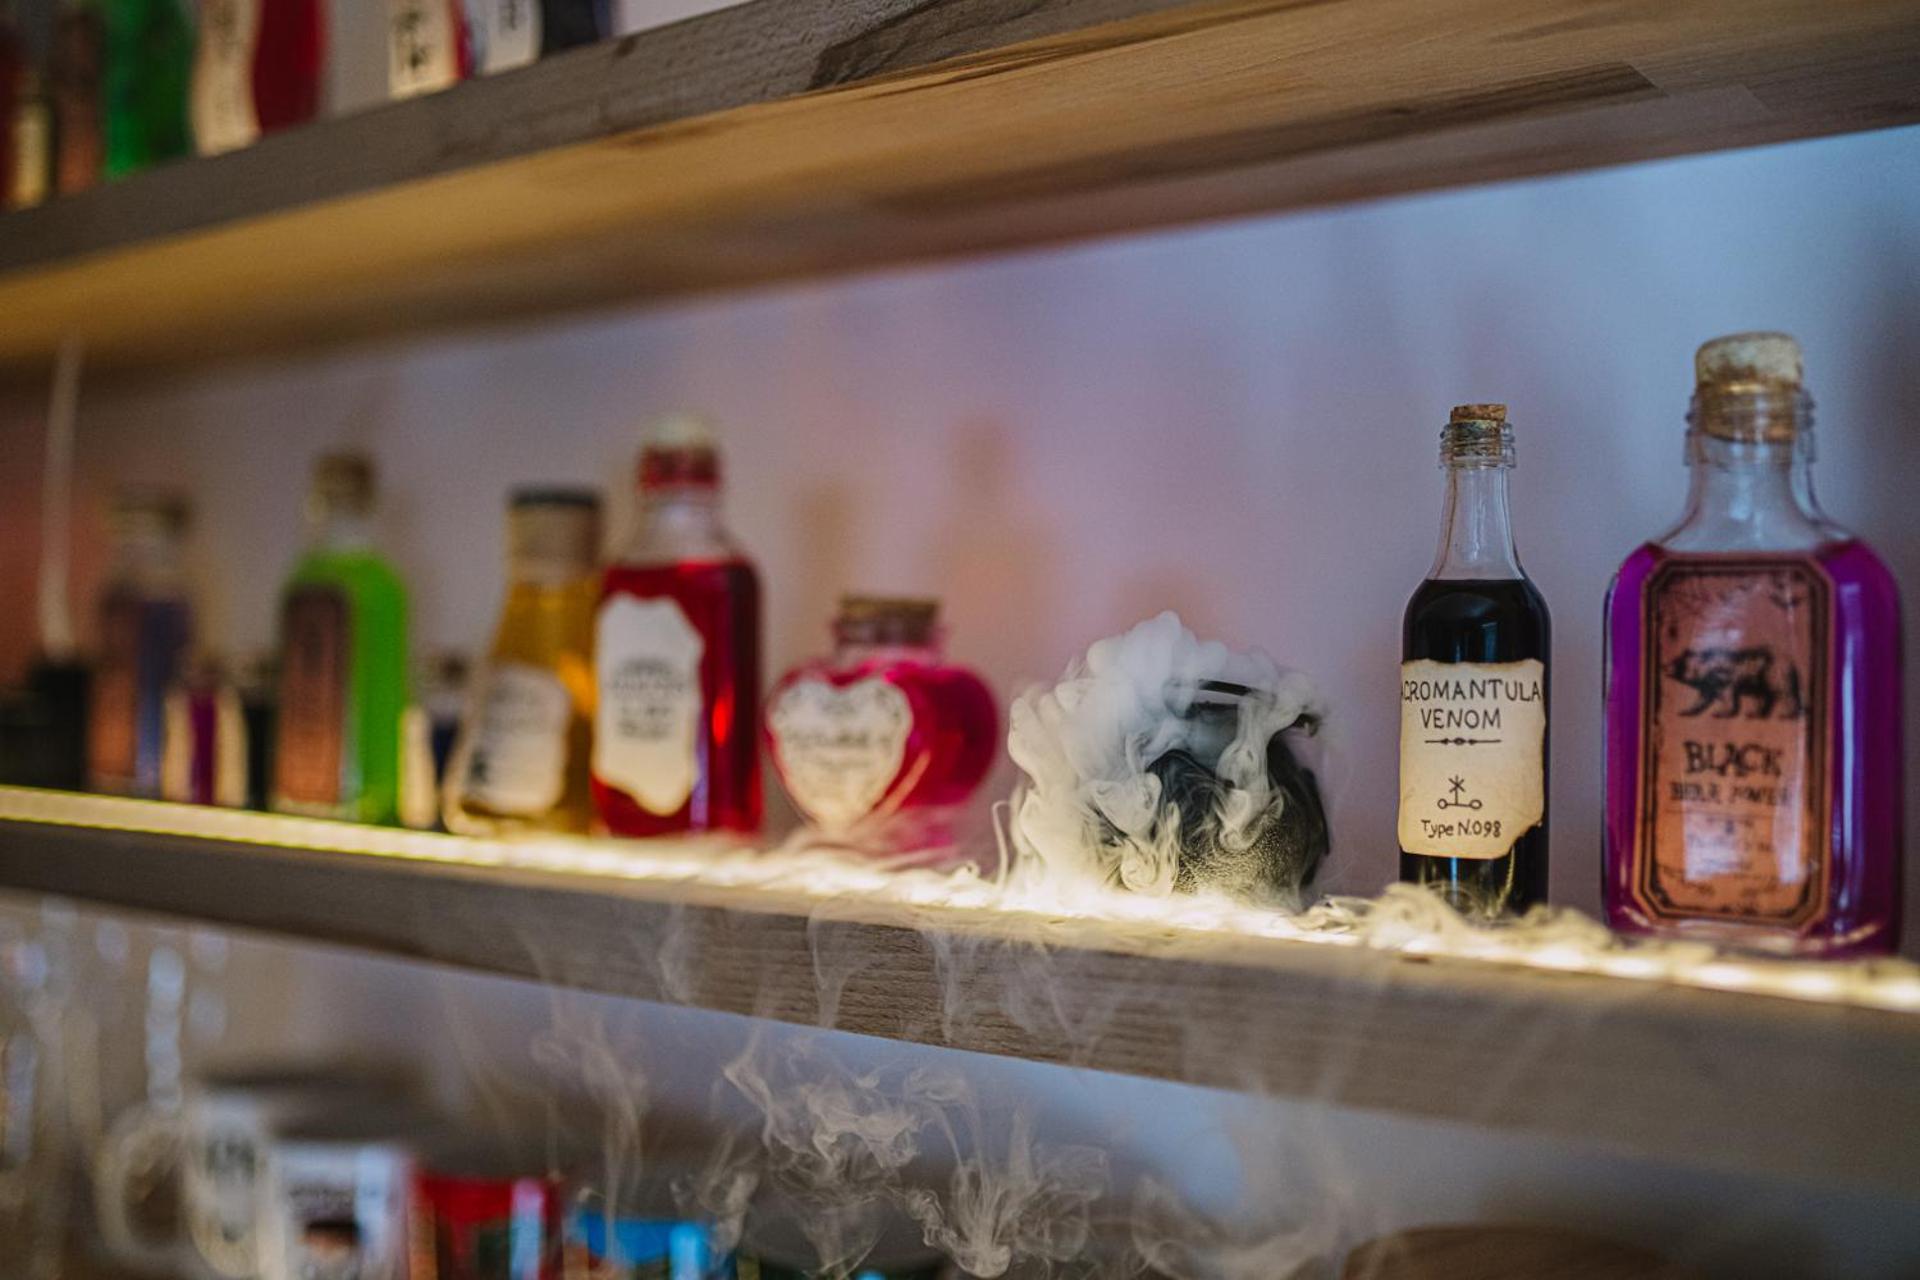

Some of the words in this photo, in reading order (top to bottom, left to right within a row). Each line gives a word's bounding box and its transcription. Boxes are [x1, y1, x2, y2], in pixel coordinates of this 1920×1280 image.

[1421, 708, 1502, 729] VENOM
[1685, 741, 1782, 776] BLACK
[1421, 819, 1454, 838] Type
